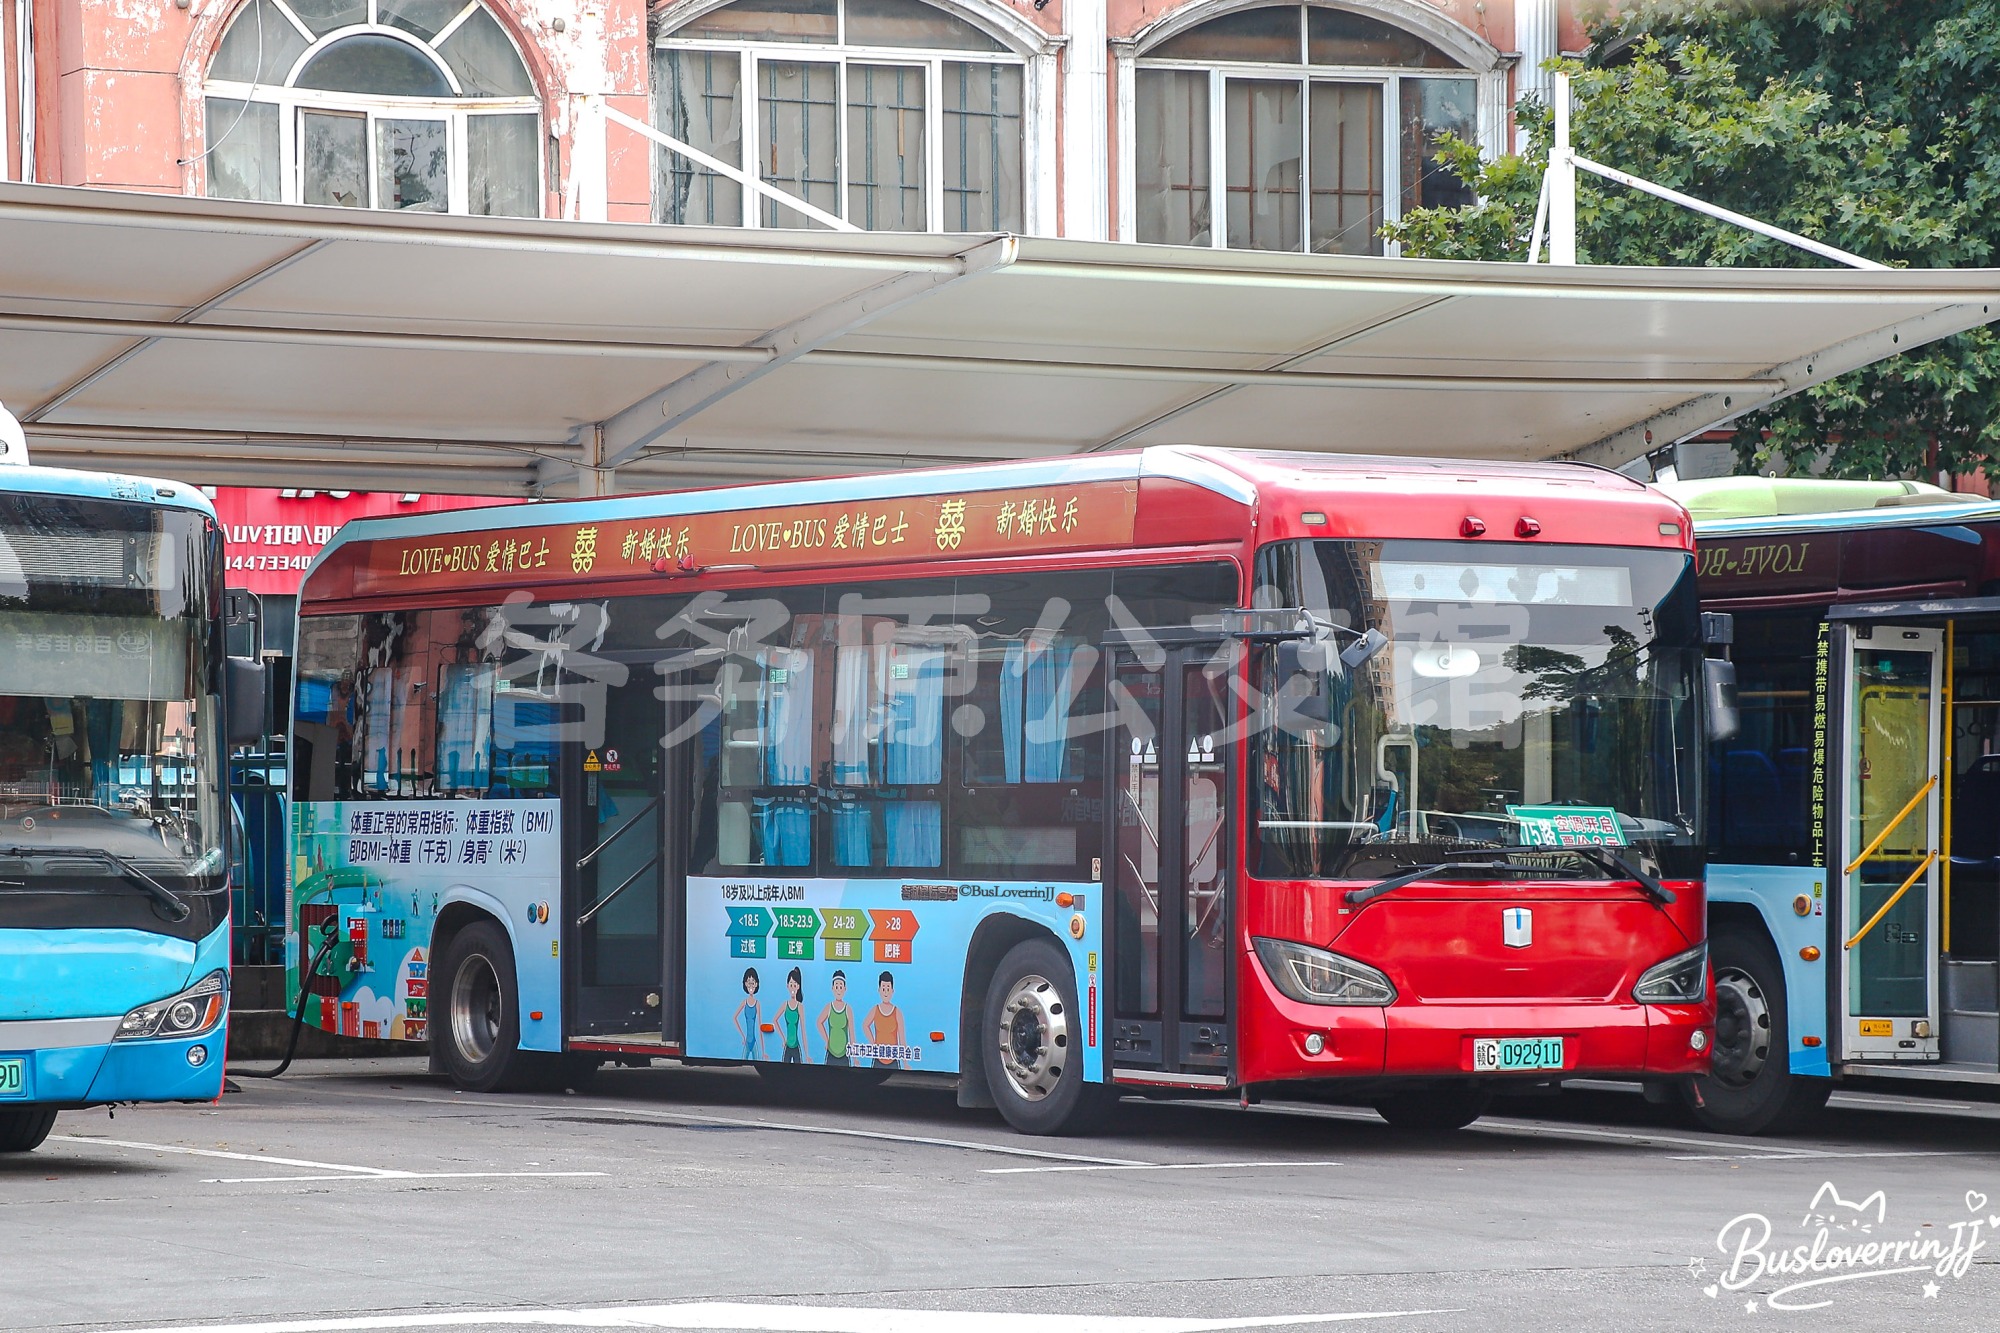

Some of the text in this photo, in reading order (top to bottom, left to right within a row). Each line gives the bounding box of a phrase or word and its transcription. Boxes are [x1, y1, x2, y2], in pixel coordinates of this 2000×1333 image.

[484, 537, 550, 573] 爱情巴士
[621, 526, 691, 565] 新婚快乐
[831, 511, 909, 550] 爱情巴士
[996, 496, 1079, 540] 新婚快乐
[1811, 622, 1831, 869] 严禁携带易燃易爆危险物品上车
[1553, 814, 1615, 834] 空调开启
[721, 884, 805, 902] 18岁及以上成年人BMI
[738, 913, 759, 927] <18.5
[779, 914, 813, 929] 18.5-23.9
[833, 915, 856, 930] 24-28
[885, 917, 902, 931] >28
[740, 939, 756, 954] 过低
[787, 940, 803, 956] 正常
[834, 941, 851, 957] 超重
[884, 943, 901, 959] 肥胖
[846, 1043, 912, 1060] 九江市卫生健康委员会
